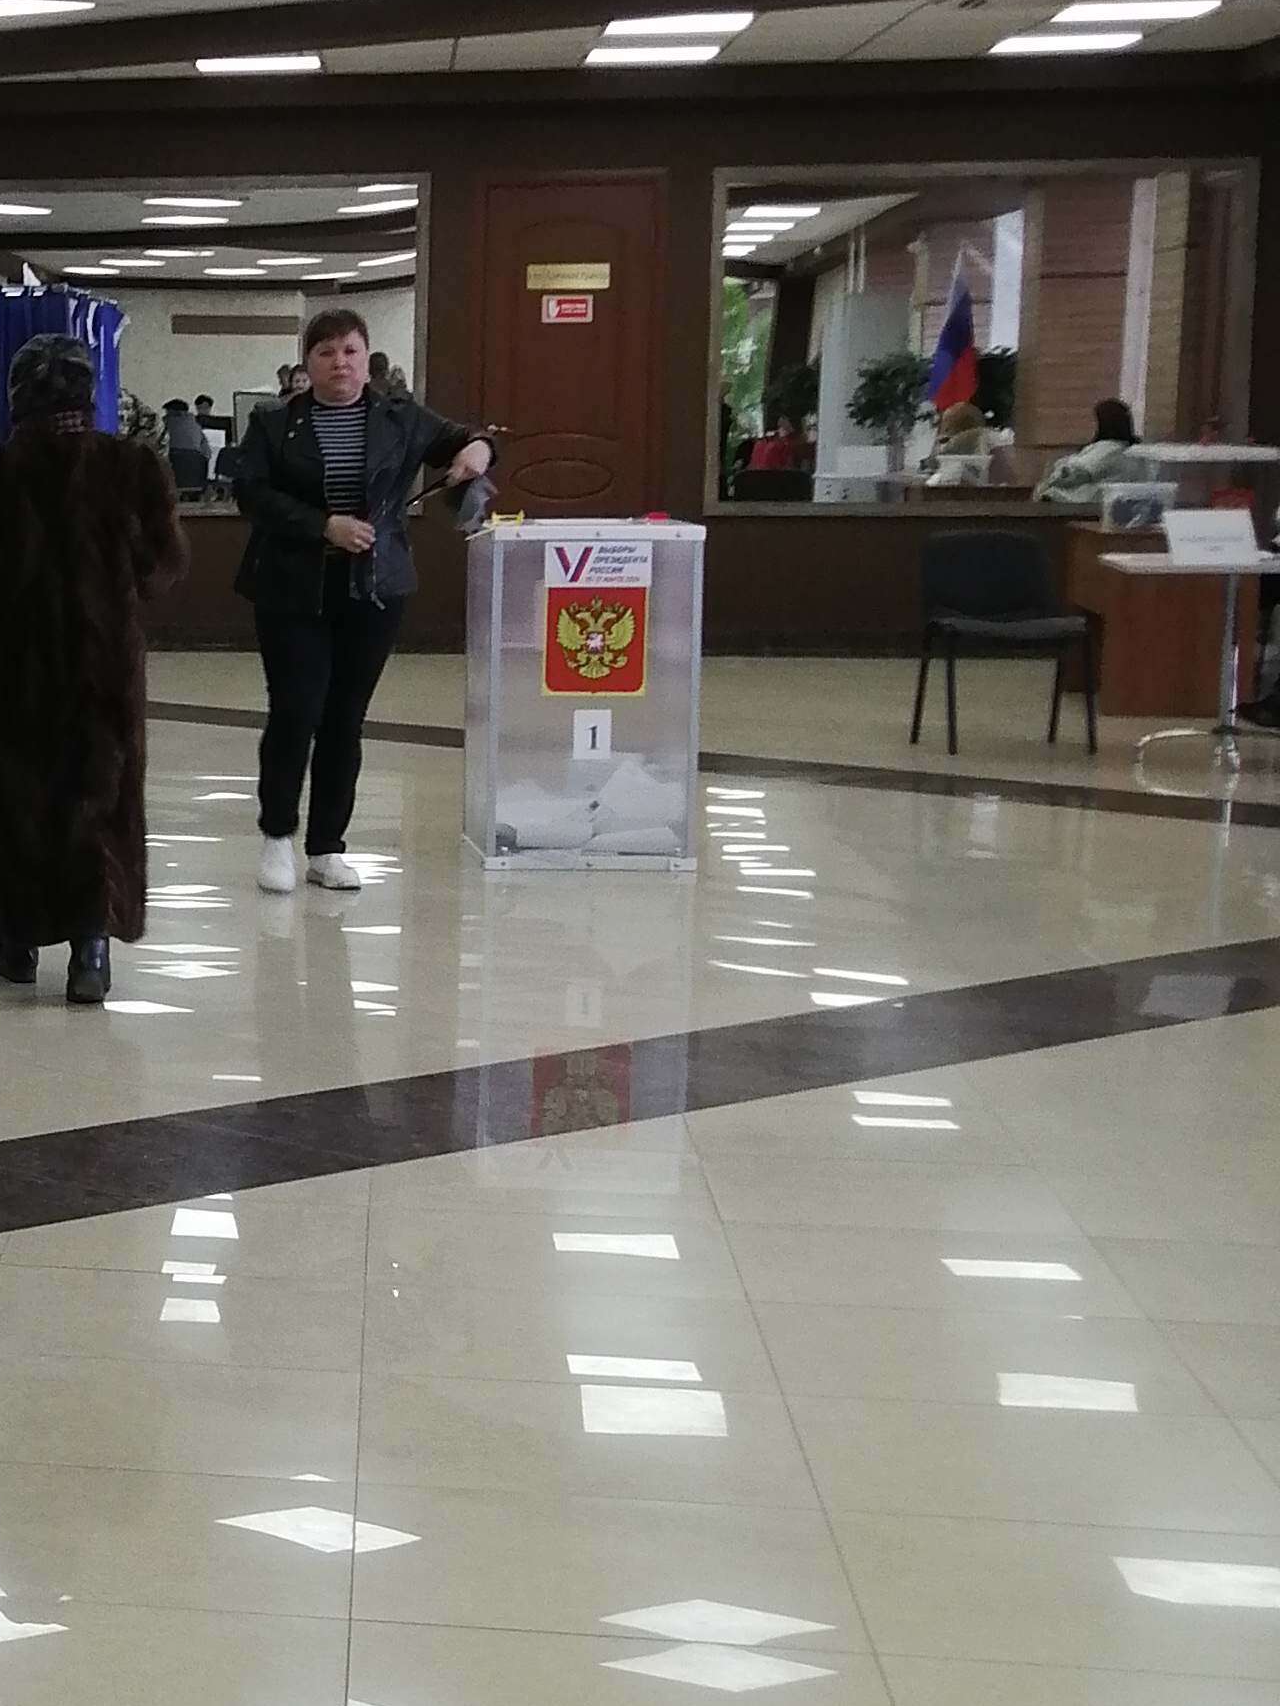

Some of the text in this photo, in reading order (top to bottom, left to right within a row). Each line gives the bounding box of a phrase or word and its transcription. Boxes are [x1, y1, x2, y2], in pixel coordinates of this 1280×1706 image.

[598, 546, 638, 554] ВЫБОРЫ
[593, 555, 649, 565] ПРЕЗИДЕНТА
[589, 566, 625, 574] РОССИИ
[588, 724, 598, 750] 1
